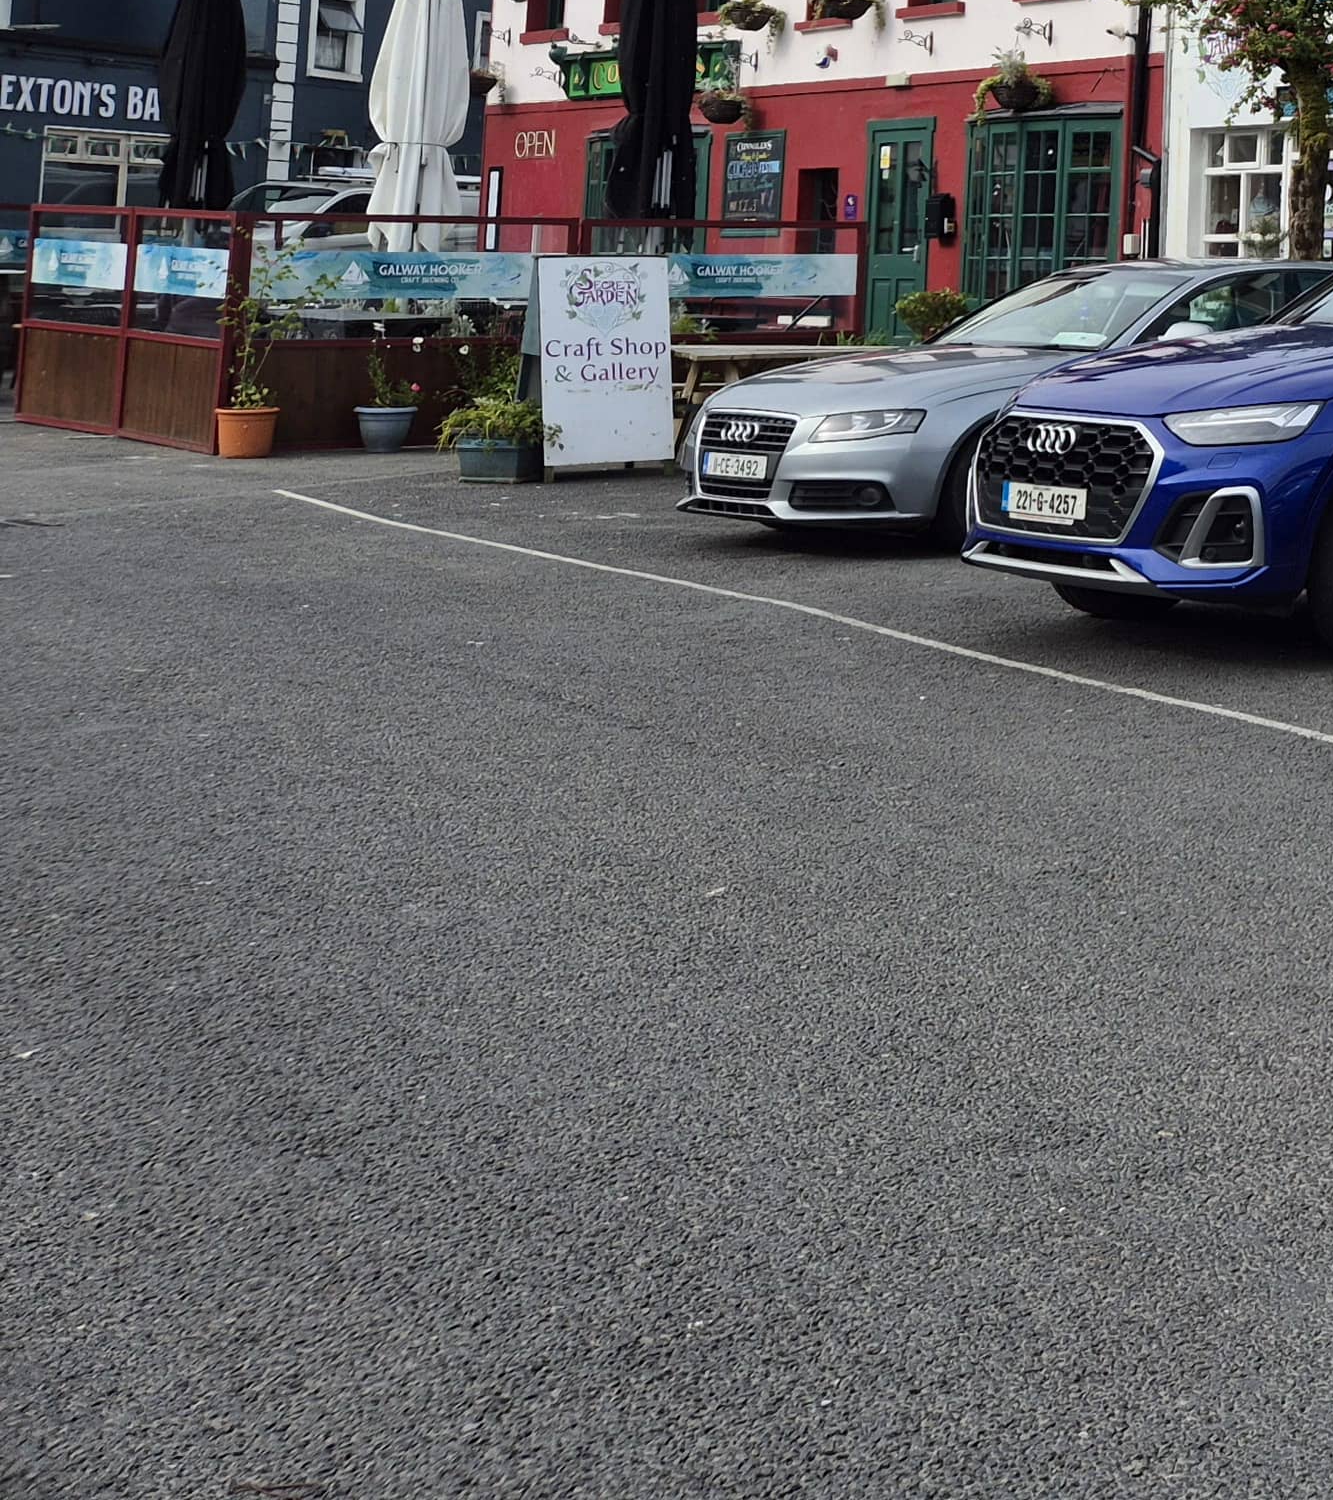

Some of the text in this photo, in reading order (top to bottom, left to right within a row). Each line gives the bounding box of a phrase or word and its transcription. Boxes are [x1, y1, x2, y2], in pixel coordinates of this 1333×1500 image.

[0, 74, 161, 122] EXTON'S BA
[514, 129, 556, 158] OPEN
[378, 263, 483, 276] GALWAY HOOKER
[696, 266, 738, 277] GALWAY
[569, 283, 638, 308] GARDEN
[545, 337, 667, 361] Craft Shop
[554, 362, 660, 384] & Gallery
[1016, 489, 1077, 516] 221-G-4257
